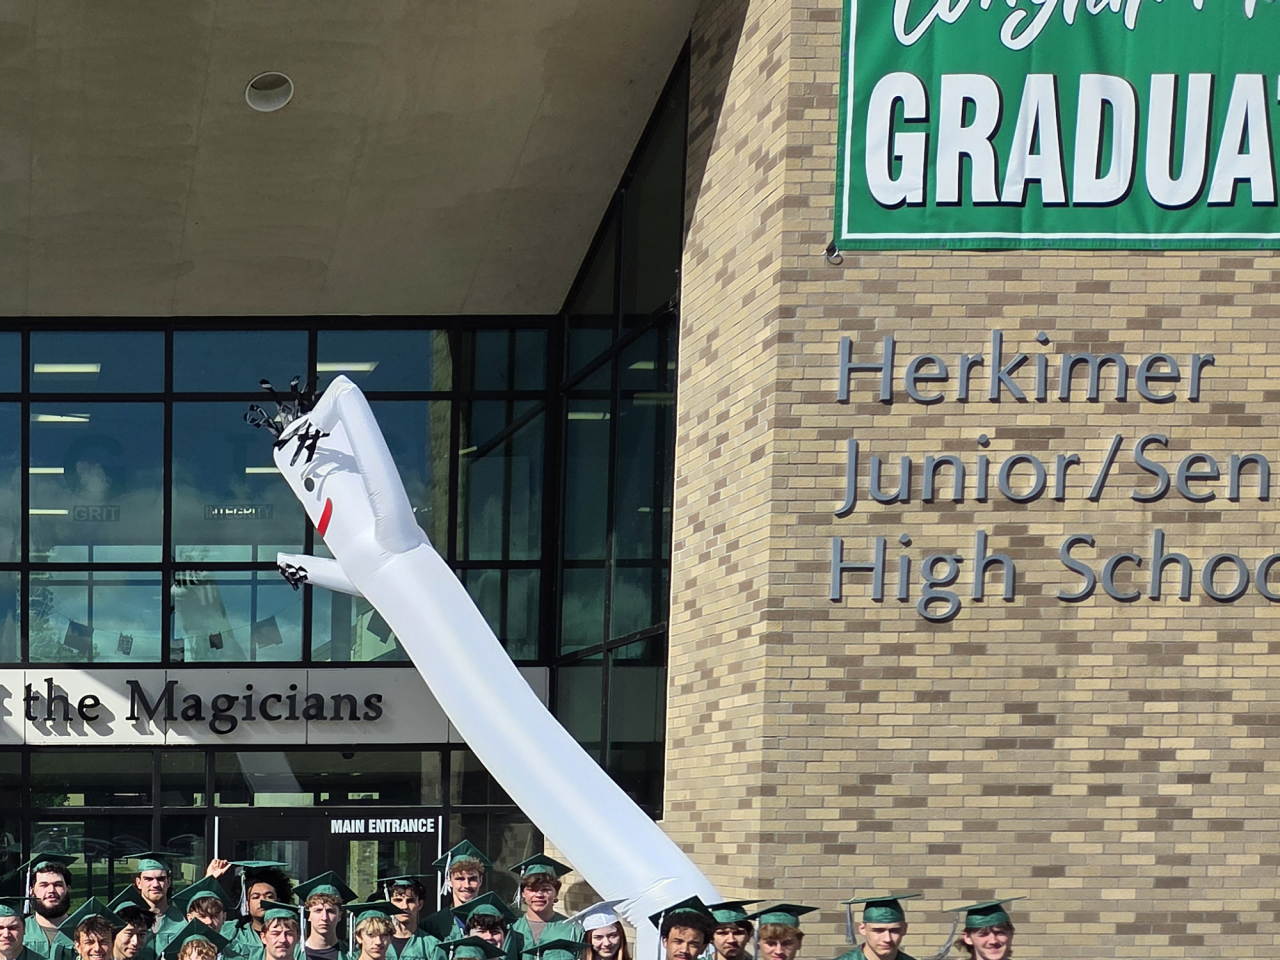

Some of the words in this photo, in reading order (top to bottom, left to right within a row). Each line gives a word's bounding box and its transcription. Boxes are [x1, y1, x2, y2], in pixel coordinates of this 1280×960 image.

[864, 71, 1280, 209] GRADUA
[836, 329, 1215, 404] Herkimer
[834, 433, 1271, 518] Junior/Sen
[73, 506, 119, 521] GRIT
[205, 505, 272, 519] INTEGRITY
[828, 529, 1016, 622] High
[24, 677, 101, 722] the
[126, 679, 384, 735] Magicians
[330, 819, 365, 834] MAIN
[368, 818, 436, 834] ENTRANCE
